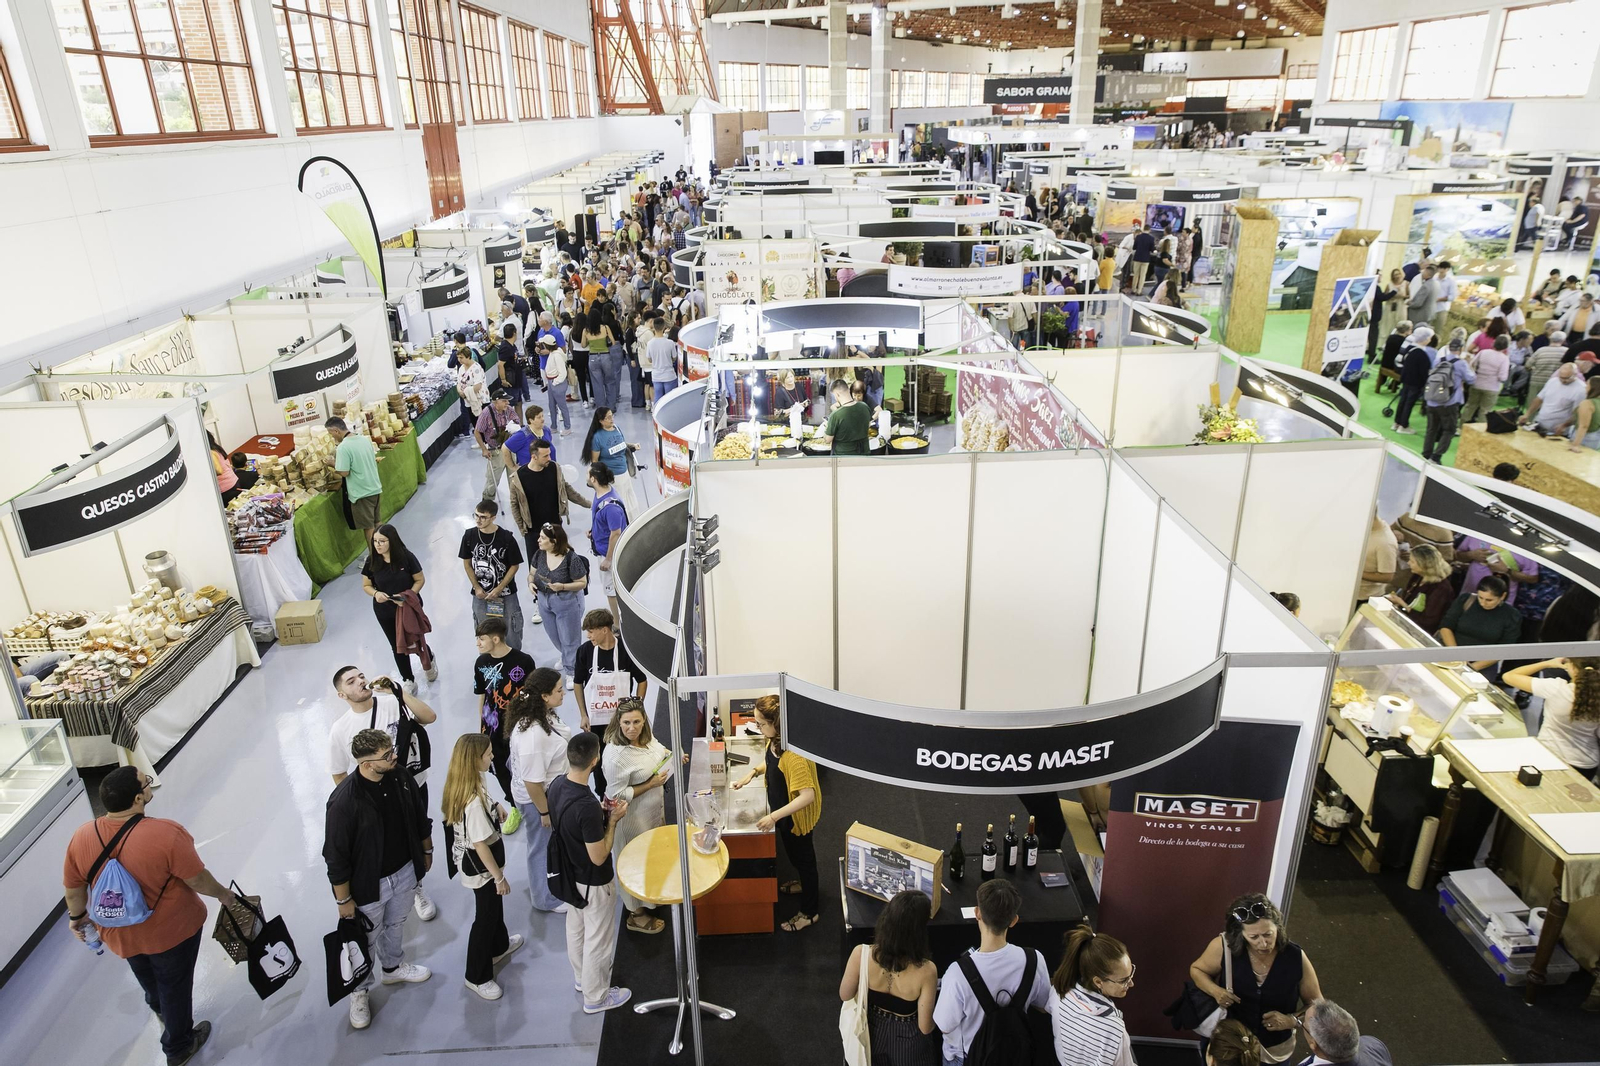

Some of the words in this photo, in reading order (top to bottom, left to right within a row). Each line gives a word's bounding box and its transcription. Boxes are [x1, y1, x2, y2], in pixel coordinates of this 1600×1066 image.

[996, 86, 1034, 97] SABOR
[446, 291, 453, 299] EL
[711, 291, 755, 299] CHOCOLATE
[315, 364, 343, 382] QUESOS
[341, 361, 349, 374] LA
[1029, 387, 1055, 430] Sáez
[81, 489, 136, 520] QUESOS
[136, 470, 169, 499] CASTRO
[915, 747, 1033, 772] BODEGAS
[1037, 740, 1115, 771] MASET
[1143, 797, 1250, 818] MASET
[1145, 821, 1183, 830] VINOS
[1200, 824, 1242, 833] CAVAS
[1138, 835, 1166, 846] Directo
[1165, 837, 1174, 846] de
[1176, 838, 1184, 847] la
[1184, 838, 1211, 849] bodega
